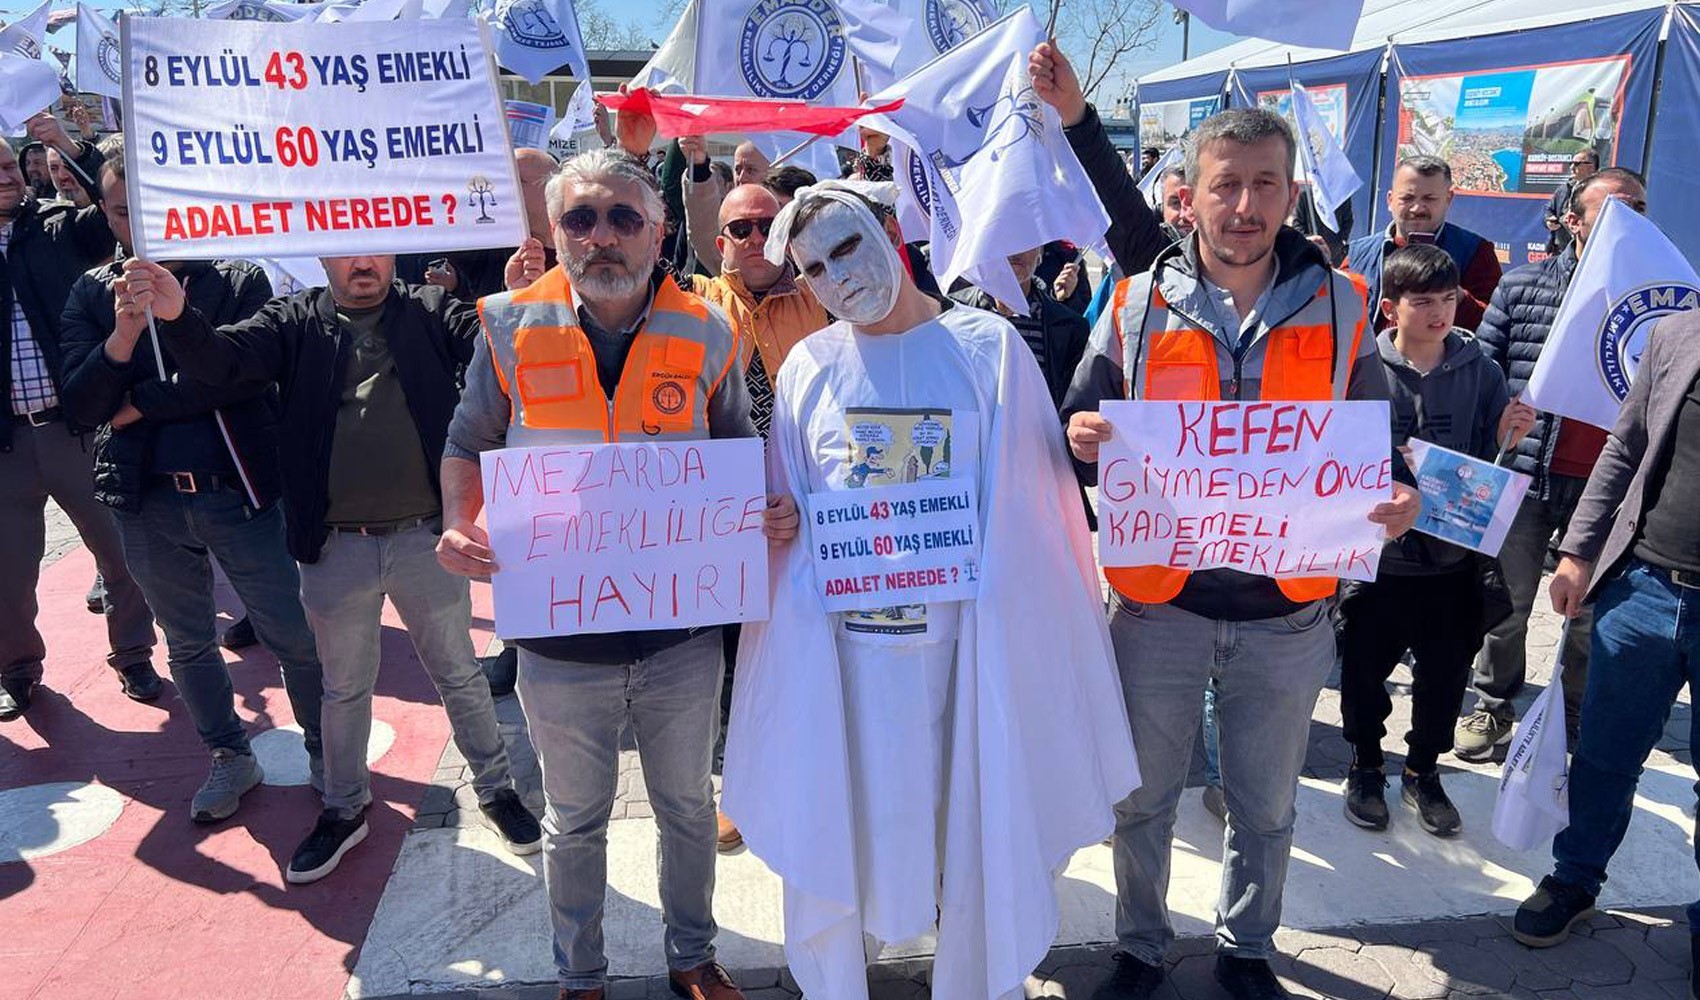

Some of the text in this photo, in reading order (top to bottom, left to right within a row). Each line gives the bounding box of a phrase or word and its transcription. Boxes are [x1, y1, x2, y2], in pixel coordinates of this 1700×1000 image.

[144, 55, 158, 86] 8
[167, 49, 261, 87] EYLÜL
[264, 51, 308, 90] 43
[310, 54, 369, 93] YAŞ
[378, 44, 471, 84] EMEKLİ
[151, 131, 168, 165] 9
[176, 124, 273, 165] EYLÜL
[275, 126, 319, 167] 60
[320, 128, 379, 169] YAŞ
[387, 113, 484, 159] EMEKLİ
[164, 194, 458, 241] ADALET NEREDE ?
[1176, 402, 1333, 458] KEFEN
[491, 447, 706, 504] MEZARDA
[1103, 454, 1310, 502] GİYMEDEN
[1314, 451, 1392, 498] ÖNCE
[526, 496, 764, 560] EMEKLİLİĞE
[816, 491, 970, 525] 8 EYLÜL 43 YAŞ EMEKLİ
[1109, 510, 1289, 547] KADEMELİ
[819, 524, 974, 561] 9 EYLÜL 60 YAŞ EMEKLİ
[1168, 538, 1376, 576] EMEKLİLİK
[825, 566, 959, 597] ADALET NEREDE ?
